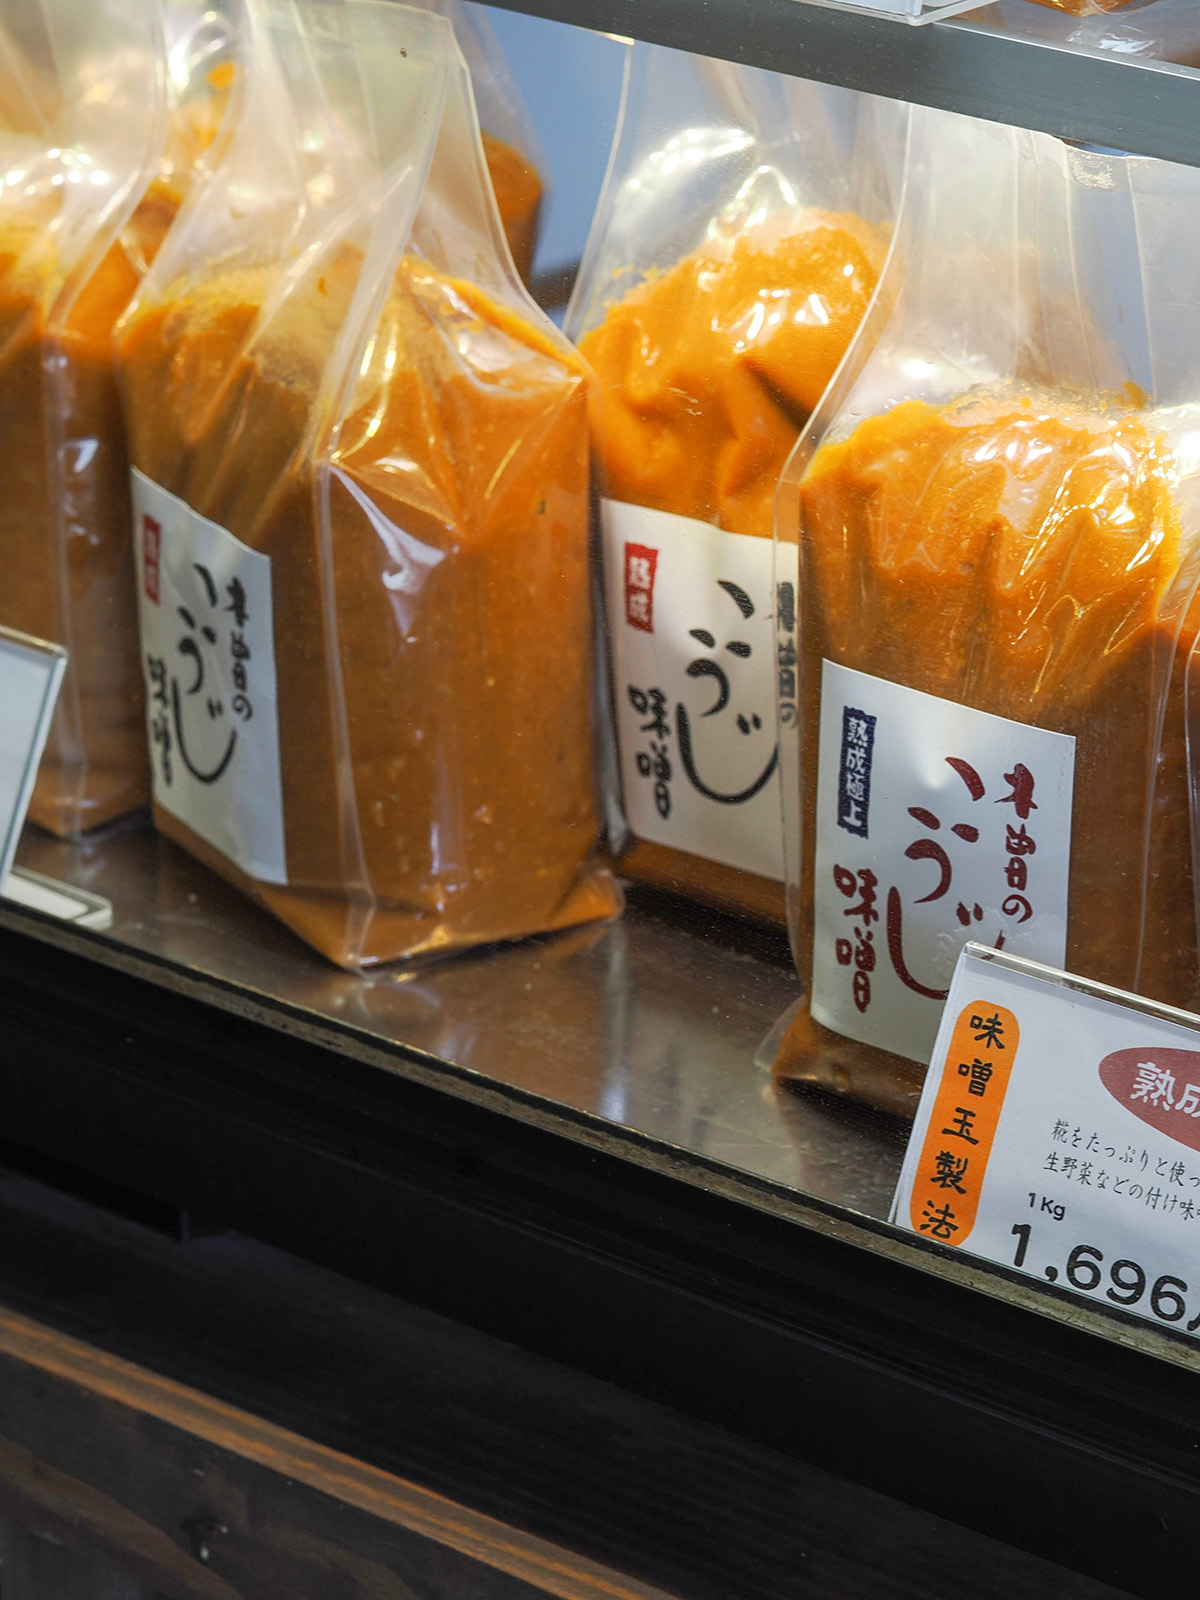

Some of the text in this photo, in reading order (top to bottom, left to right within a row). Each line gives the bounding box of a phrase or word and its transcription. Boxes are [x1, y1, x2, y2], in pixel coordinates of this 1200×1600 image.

[843, 716, 870, 829] 熟成極上
[833, 863, 880, 1014] 味噌
[919, 1012, 1006, 1241] 味噌玉製法
